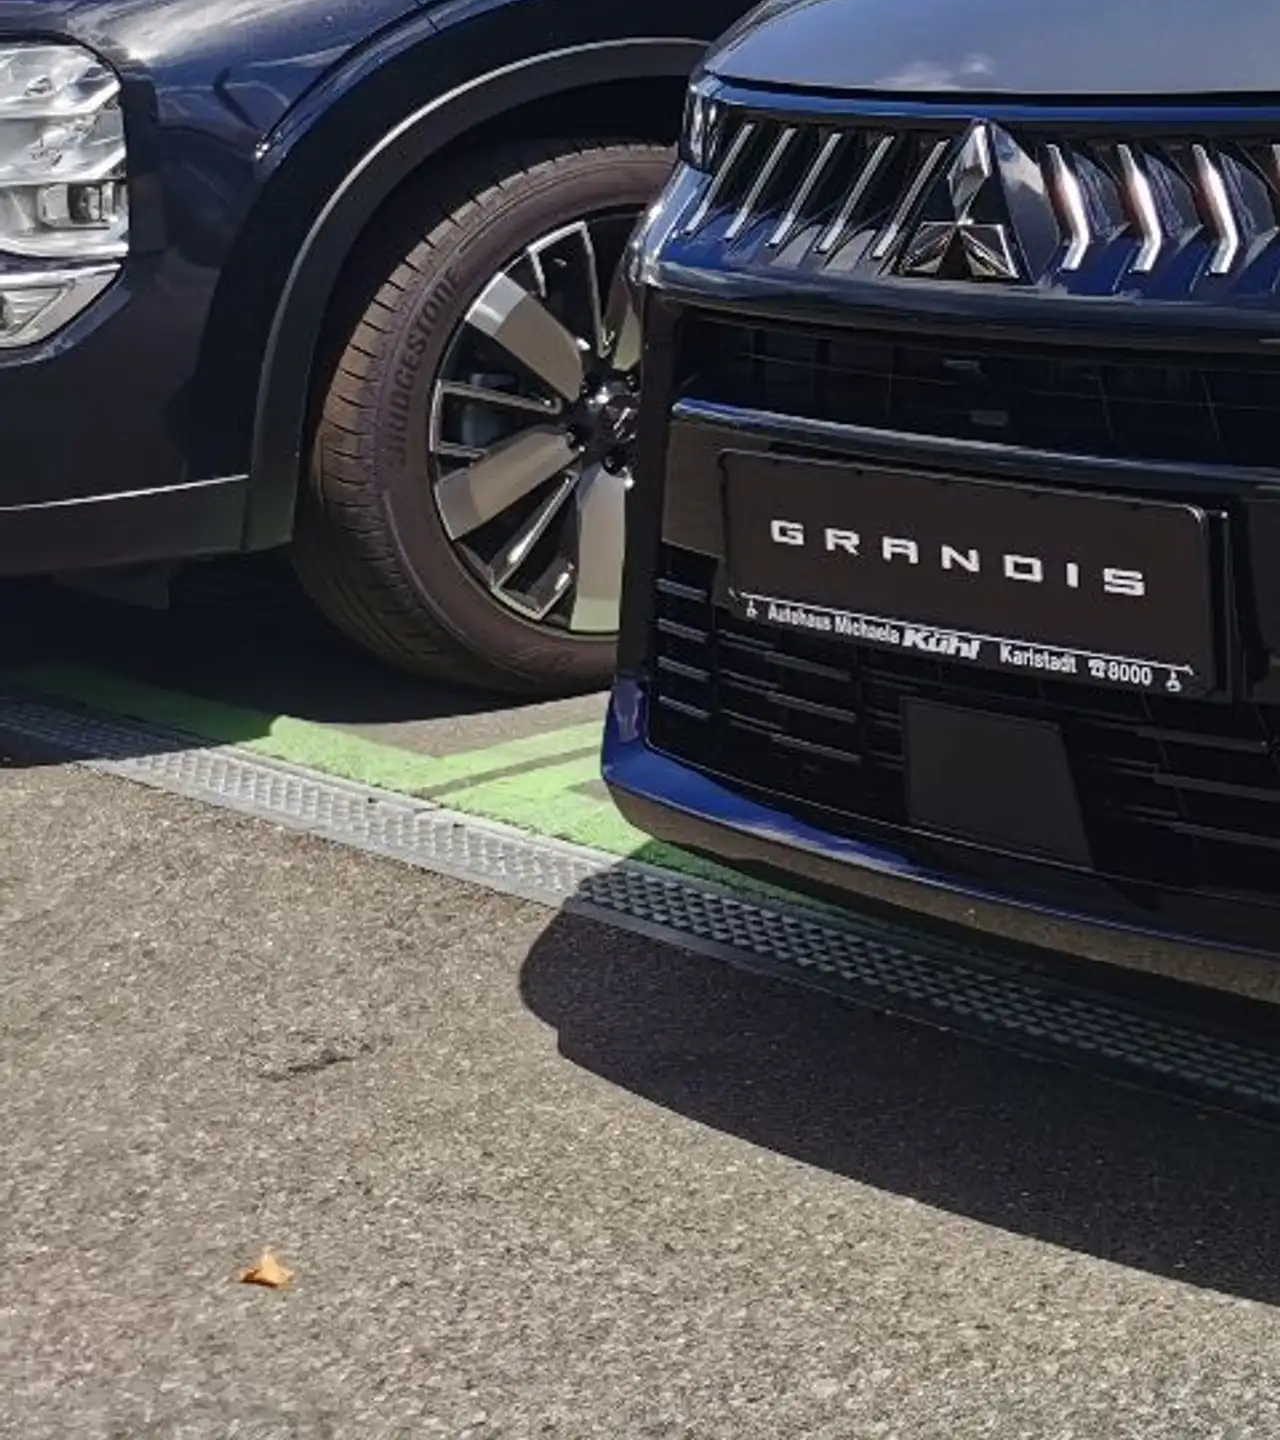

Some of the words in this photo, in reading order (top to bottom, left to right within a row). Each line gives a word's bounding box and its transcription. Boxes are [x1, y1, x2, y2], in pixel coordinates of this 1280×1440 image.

[769, 518, 1147, 597] GRANDIS
[767, 602, 832, 634] Autohaus
[834, 614, 900, 644] Michaela
[900, 627, 981, 661] Kühl
[1000, 643, 1078, 675] Karlstadt
[1107, 662, 1154, 687] 8000
